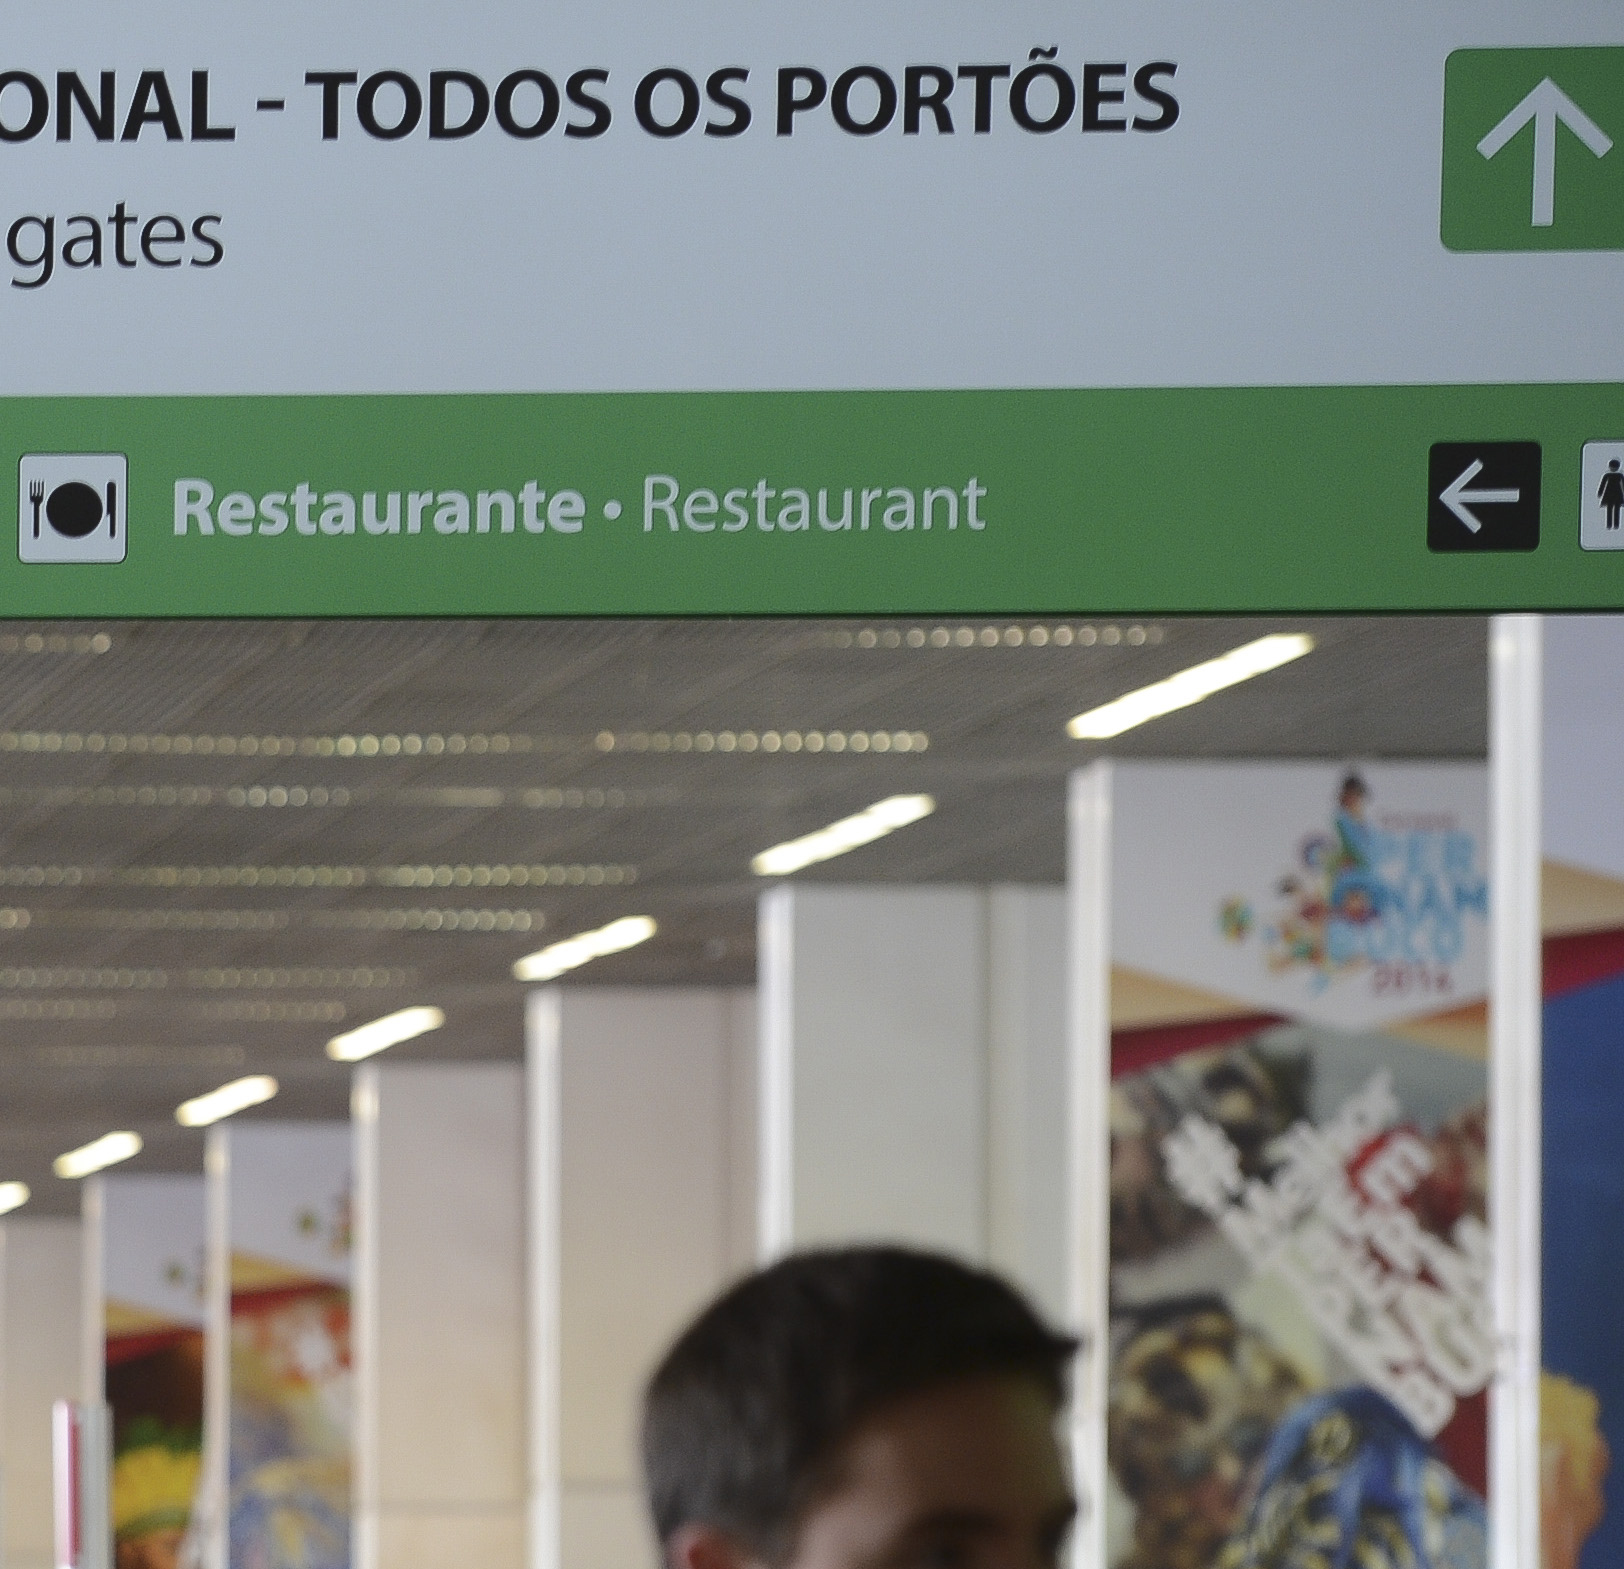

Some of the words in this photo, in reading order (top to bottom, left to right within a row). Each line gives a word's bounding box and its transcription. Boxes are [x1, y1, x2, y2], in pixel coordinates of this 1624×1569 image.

[304, 68, 612, 141] TODOS
[634, 67, 752, 138] OS
[776, 46, 1180, 137] PORTÕES
[6, 201, 224, 290] gates
[174, 480, 585, 535] Restaurante
[644, 476, 987, 532] Restaurant
